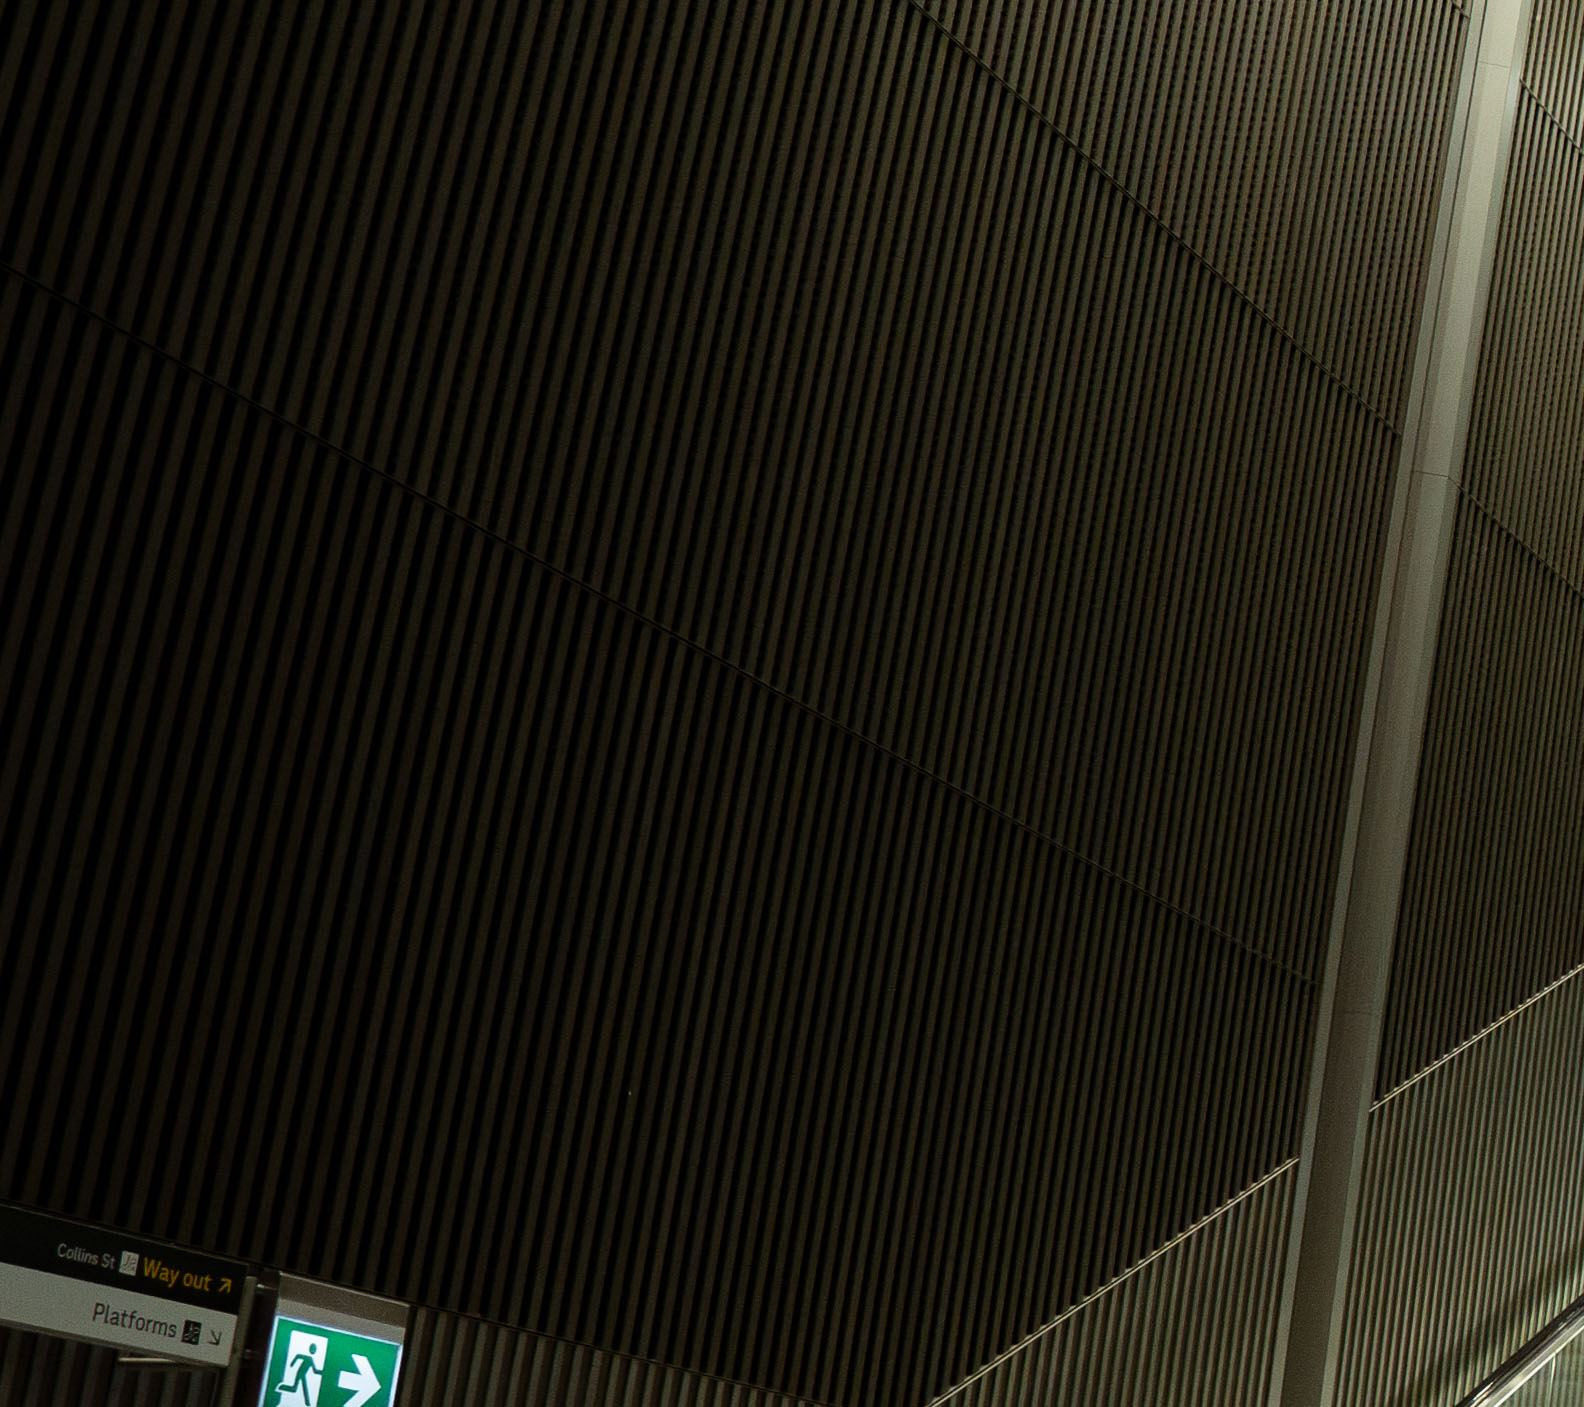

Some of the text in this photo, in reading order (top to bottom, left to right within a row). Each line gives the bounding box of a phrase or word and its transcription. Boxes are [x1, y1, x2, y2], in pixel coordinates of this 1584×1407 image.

[57, 1242, 212, 1293] Collins St Way out
[92, 1302, 178, 1338] Platforms
